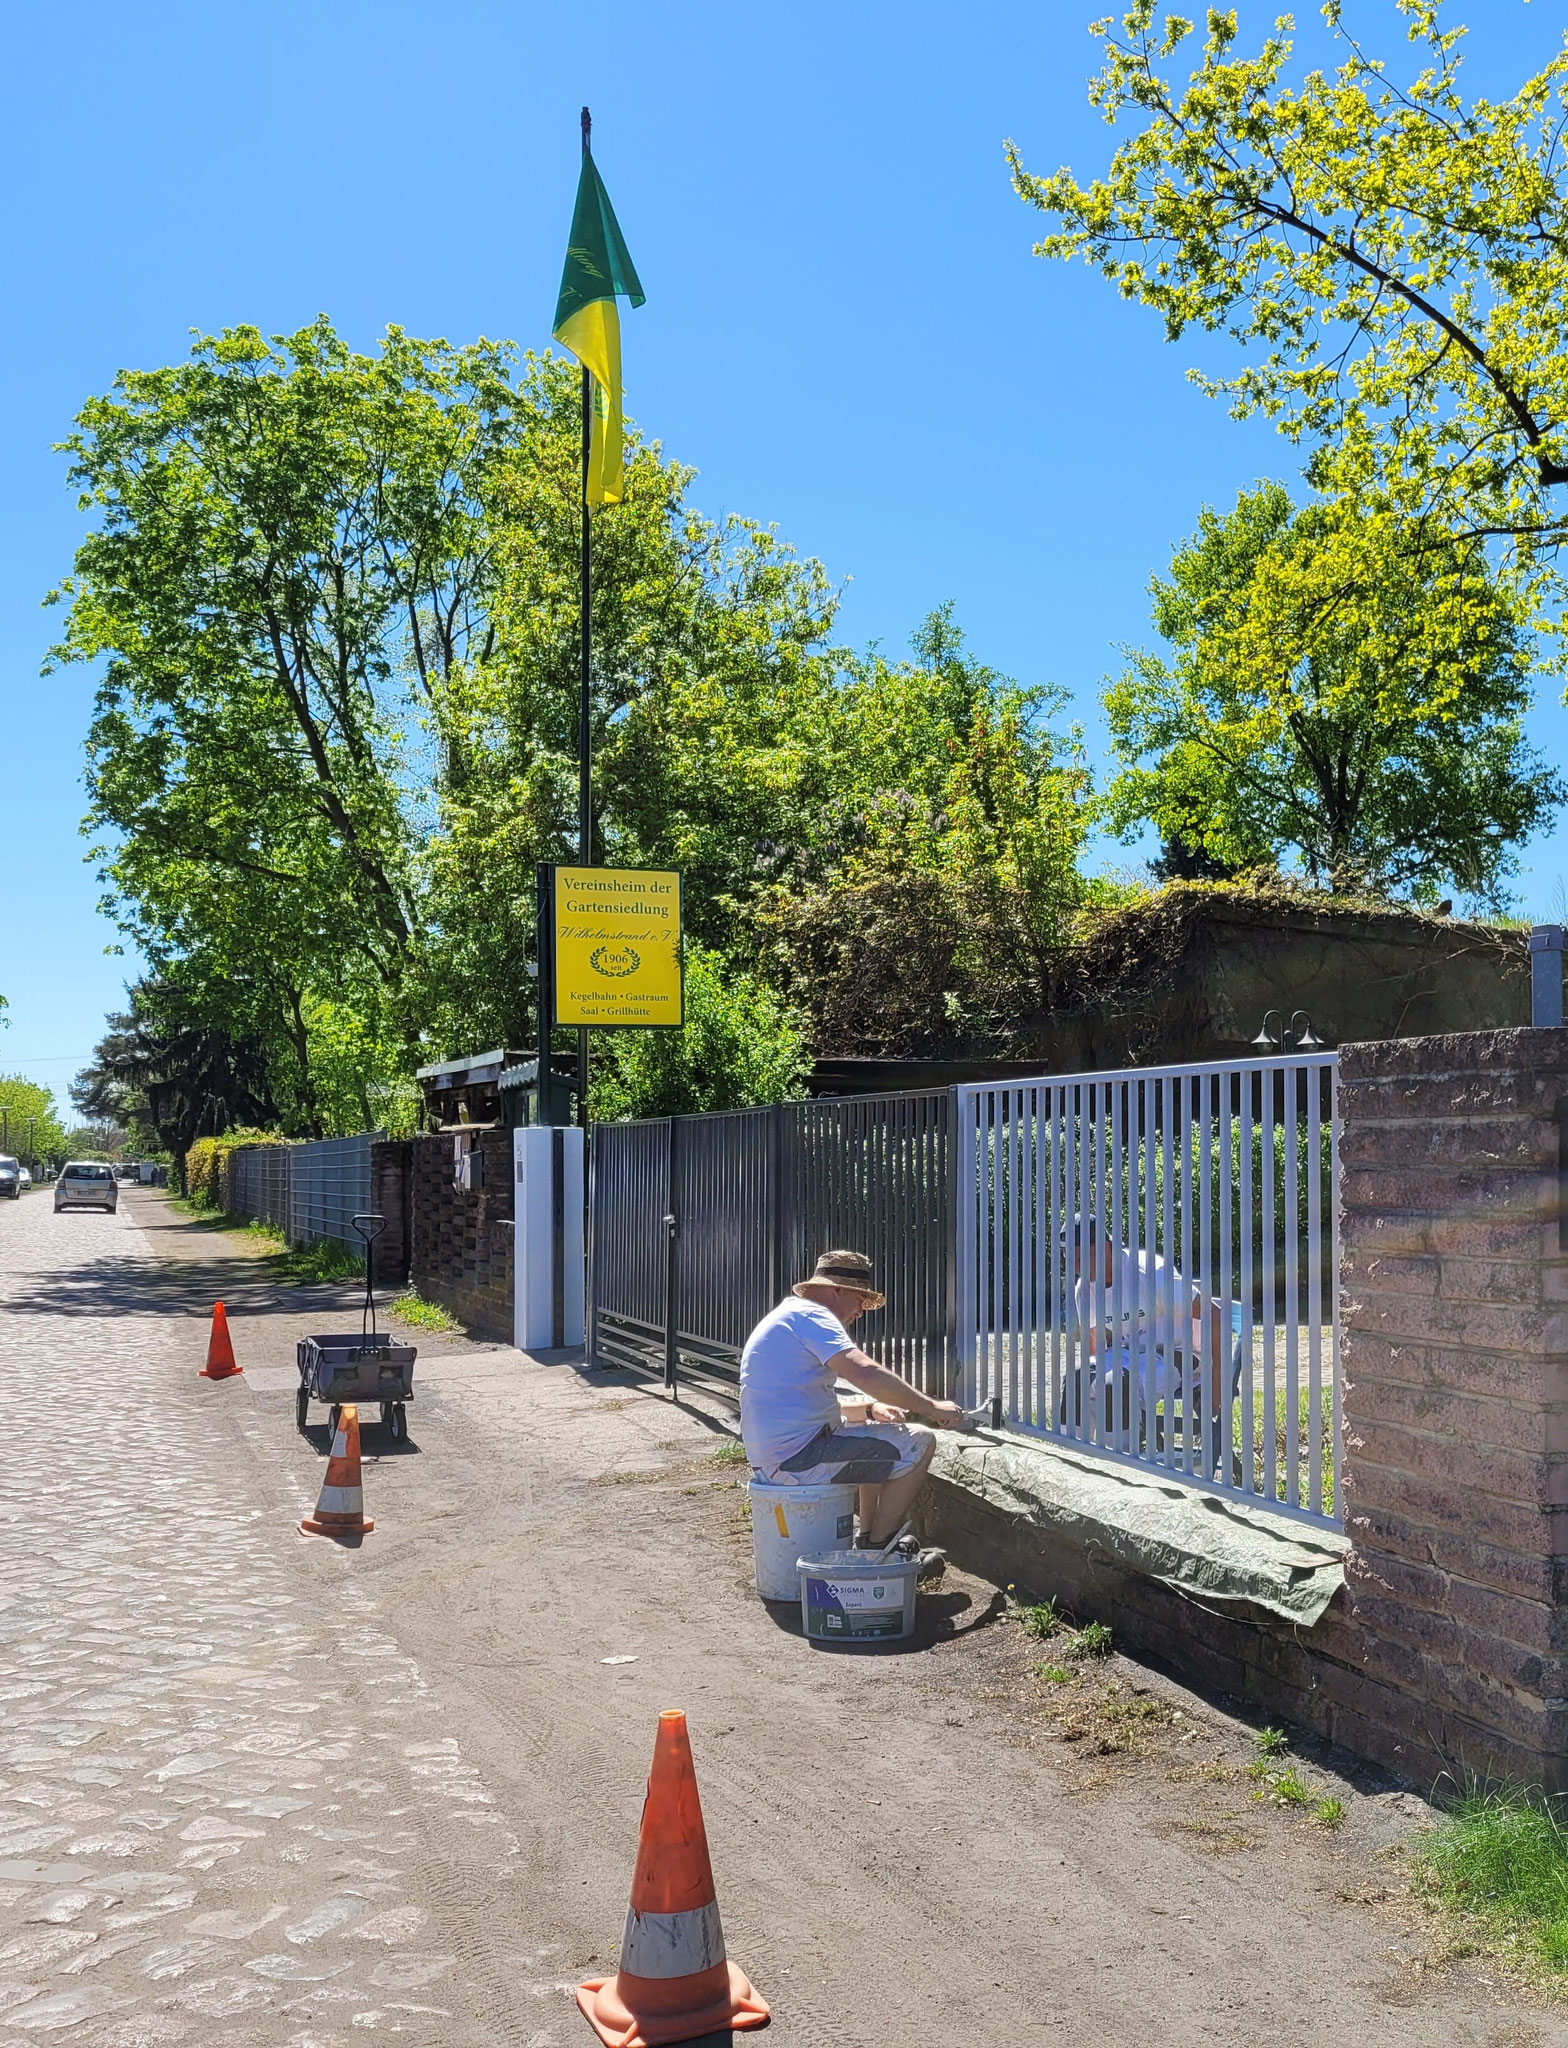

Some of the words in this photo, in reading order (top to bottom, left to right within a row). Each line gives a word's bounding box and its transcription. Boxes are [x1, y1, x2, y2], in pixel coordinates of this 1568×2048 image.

[563, 877, 646, 893] Vereinsheim
[650, 881, 672, 894] der
[566, 900, 669, 919] Gartensiedlung
[558, 926, 651, 941] Wilhelmstrand
[603, 954, 628, 964] 1906
[570, 991, 617, 1002] Kegelbahn
[625, 992, 669, 1002] Gastraum
[580, 1006, 599, 1016] Saal
[607, 1006, 651, 1016] Grillhütte
